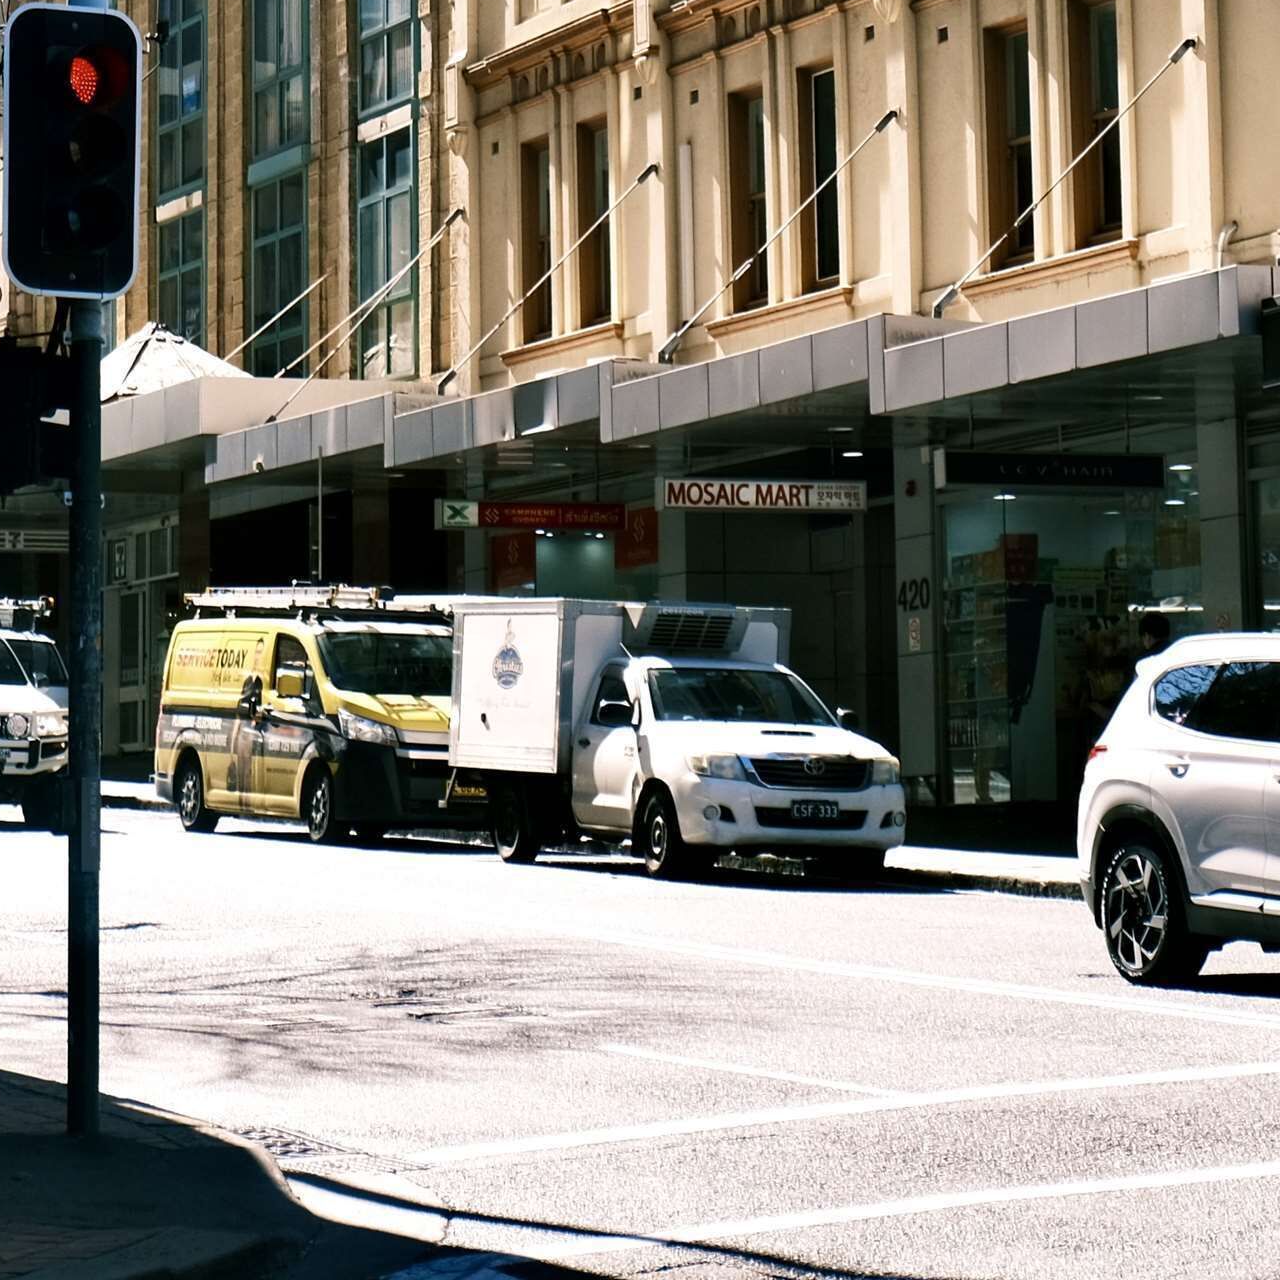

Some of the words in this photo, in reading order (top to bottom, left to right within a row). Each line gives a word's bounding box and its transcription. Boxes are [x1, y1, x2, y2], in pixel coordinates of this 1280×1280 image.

[667, 482, 750, 506] MOSAIC
[755, 483, 815, 507] MART
[898, 577, 931, 612] 420
